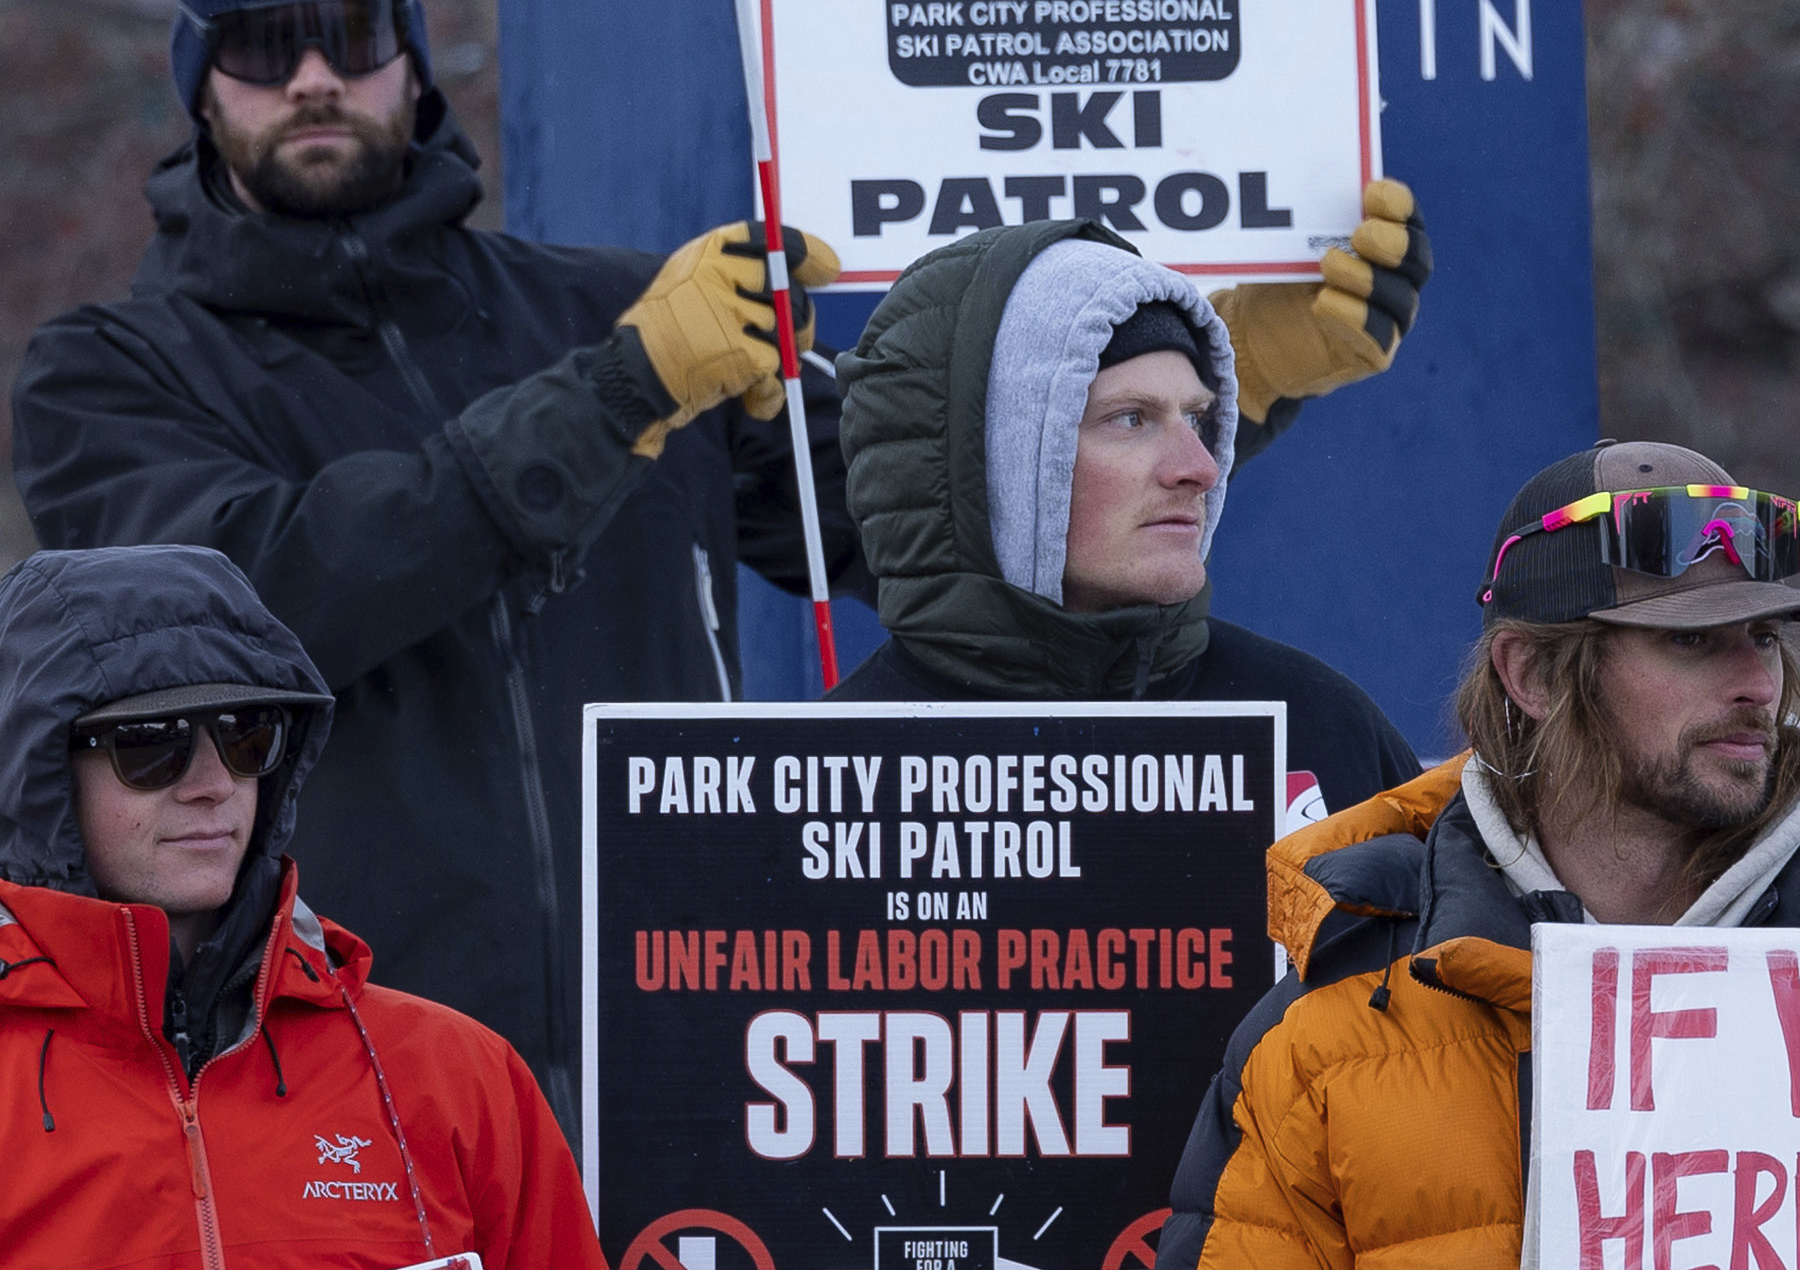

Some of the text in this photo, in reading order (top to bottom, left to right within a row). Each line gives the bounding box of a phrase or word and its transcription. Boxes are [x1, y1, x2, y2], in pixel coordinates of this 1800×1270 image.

[891, 3, 965, 27] PARK
[970, 1, 1029, 26] CITY
[896, 29, 1230, 58] SKI PATROL ASSOCIATION
[968, 59, 1161, 86] CWA Local 7781
[976, 89, 1164, 153] SKI
[850, 171, 1294, 237] PATROL
[628, 754, 1254, 814] PARK CITY PROFESSIONAL
[801, 820, 1081, 880] SKI PATROL
[886, 891, 988, 921] IS ON AN
[634, 928, 1233, 991] UNFAIR LABOR PRACTICE
[1585, 946, 1729, 1113] IF
[744, 1009, 1132, 1160] STRIKE
[904, 1241, 968, 1258] FIGHTING
